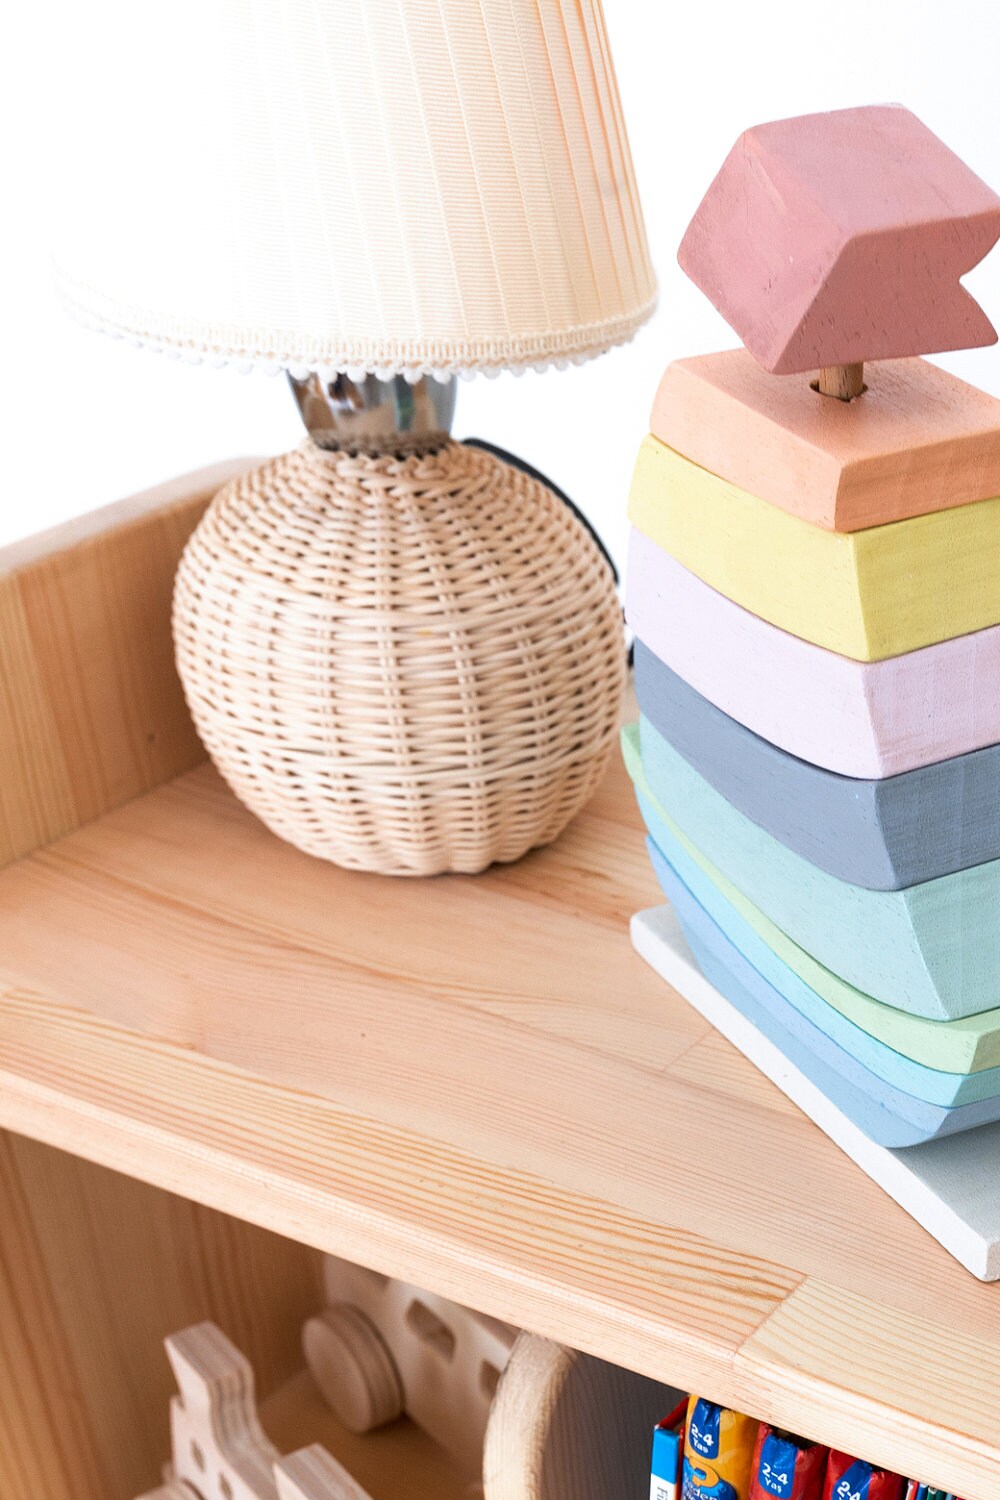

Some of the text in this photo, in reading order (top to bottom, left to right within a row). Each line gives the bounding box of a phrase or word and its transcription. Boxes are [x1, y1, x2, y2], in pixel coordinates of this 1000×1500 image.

[691, 1424, 714, 1446] 2-4
[762, 1462, 788, 1485] 2-4
[765, 1477, 782, 1494] Yaş
